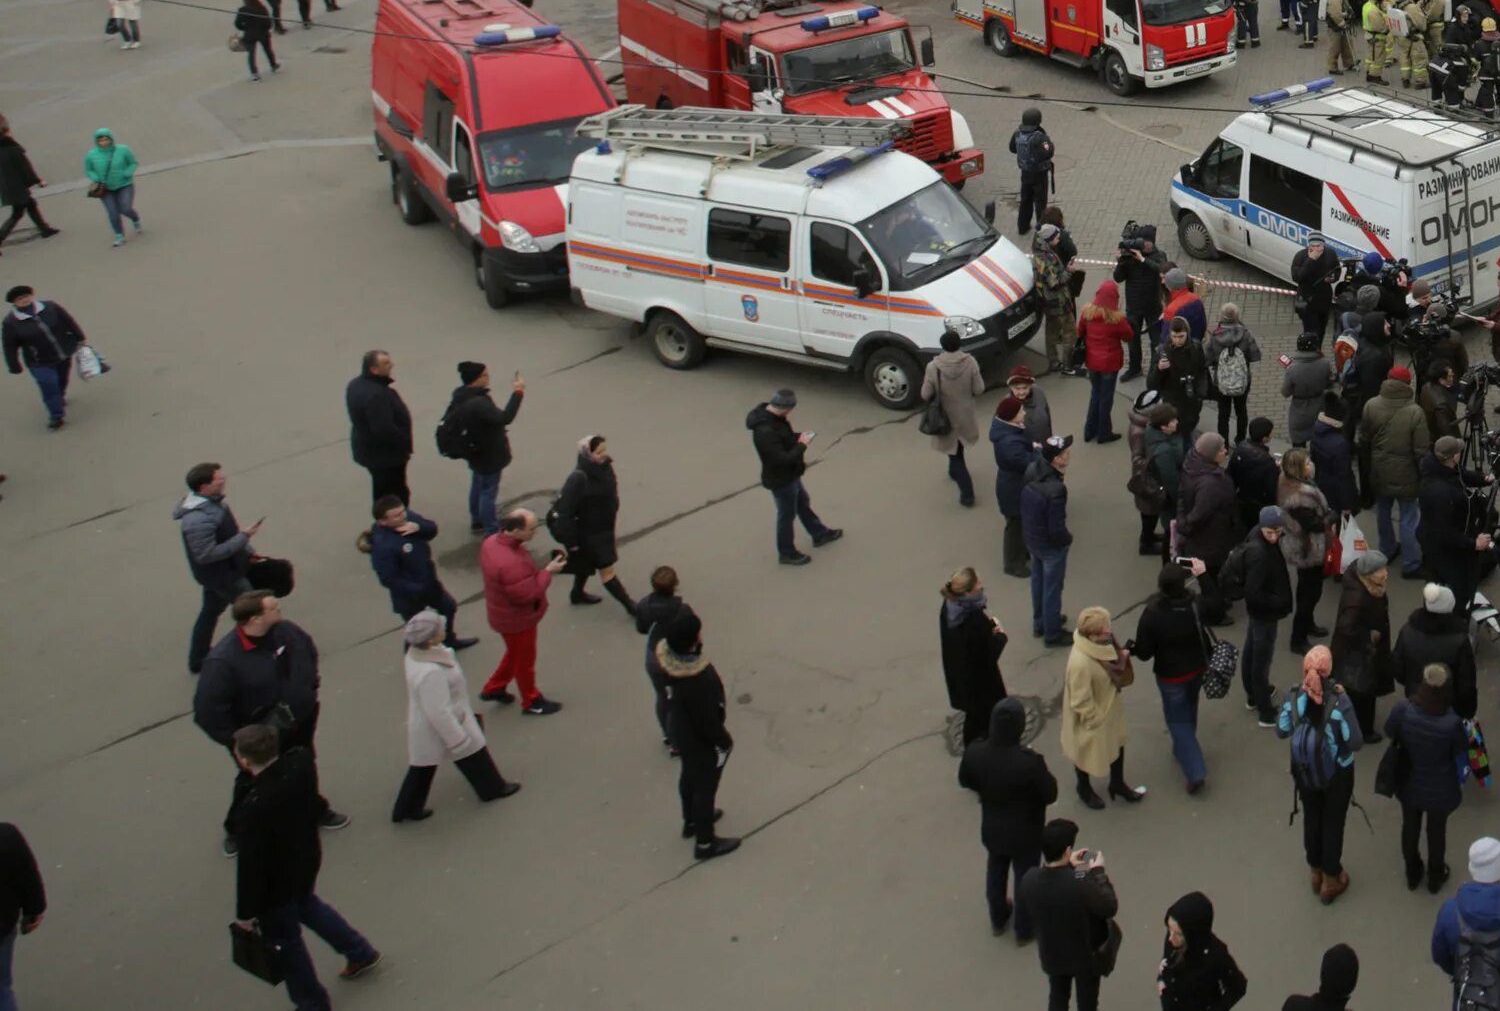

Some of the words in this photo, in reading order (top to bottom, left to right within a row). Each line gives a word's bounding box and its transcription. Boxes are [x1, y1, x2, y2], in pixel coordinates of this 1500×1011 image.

[1113, 23, 1119, 36] 4
[1258, 210, 1310, 246] ОМОН
[1330, 207, 1391, 240] РАЗМИНИРОВАНИЕ
[822, 307, 868, 321] СПЕЦЧАСТЬ
